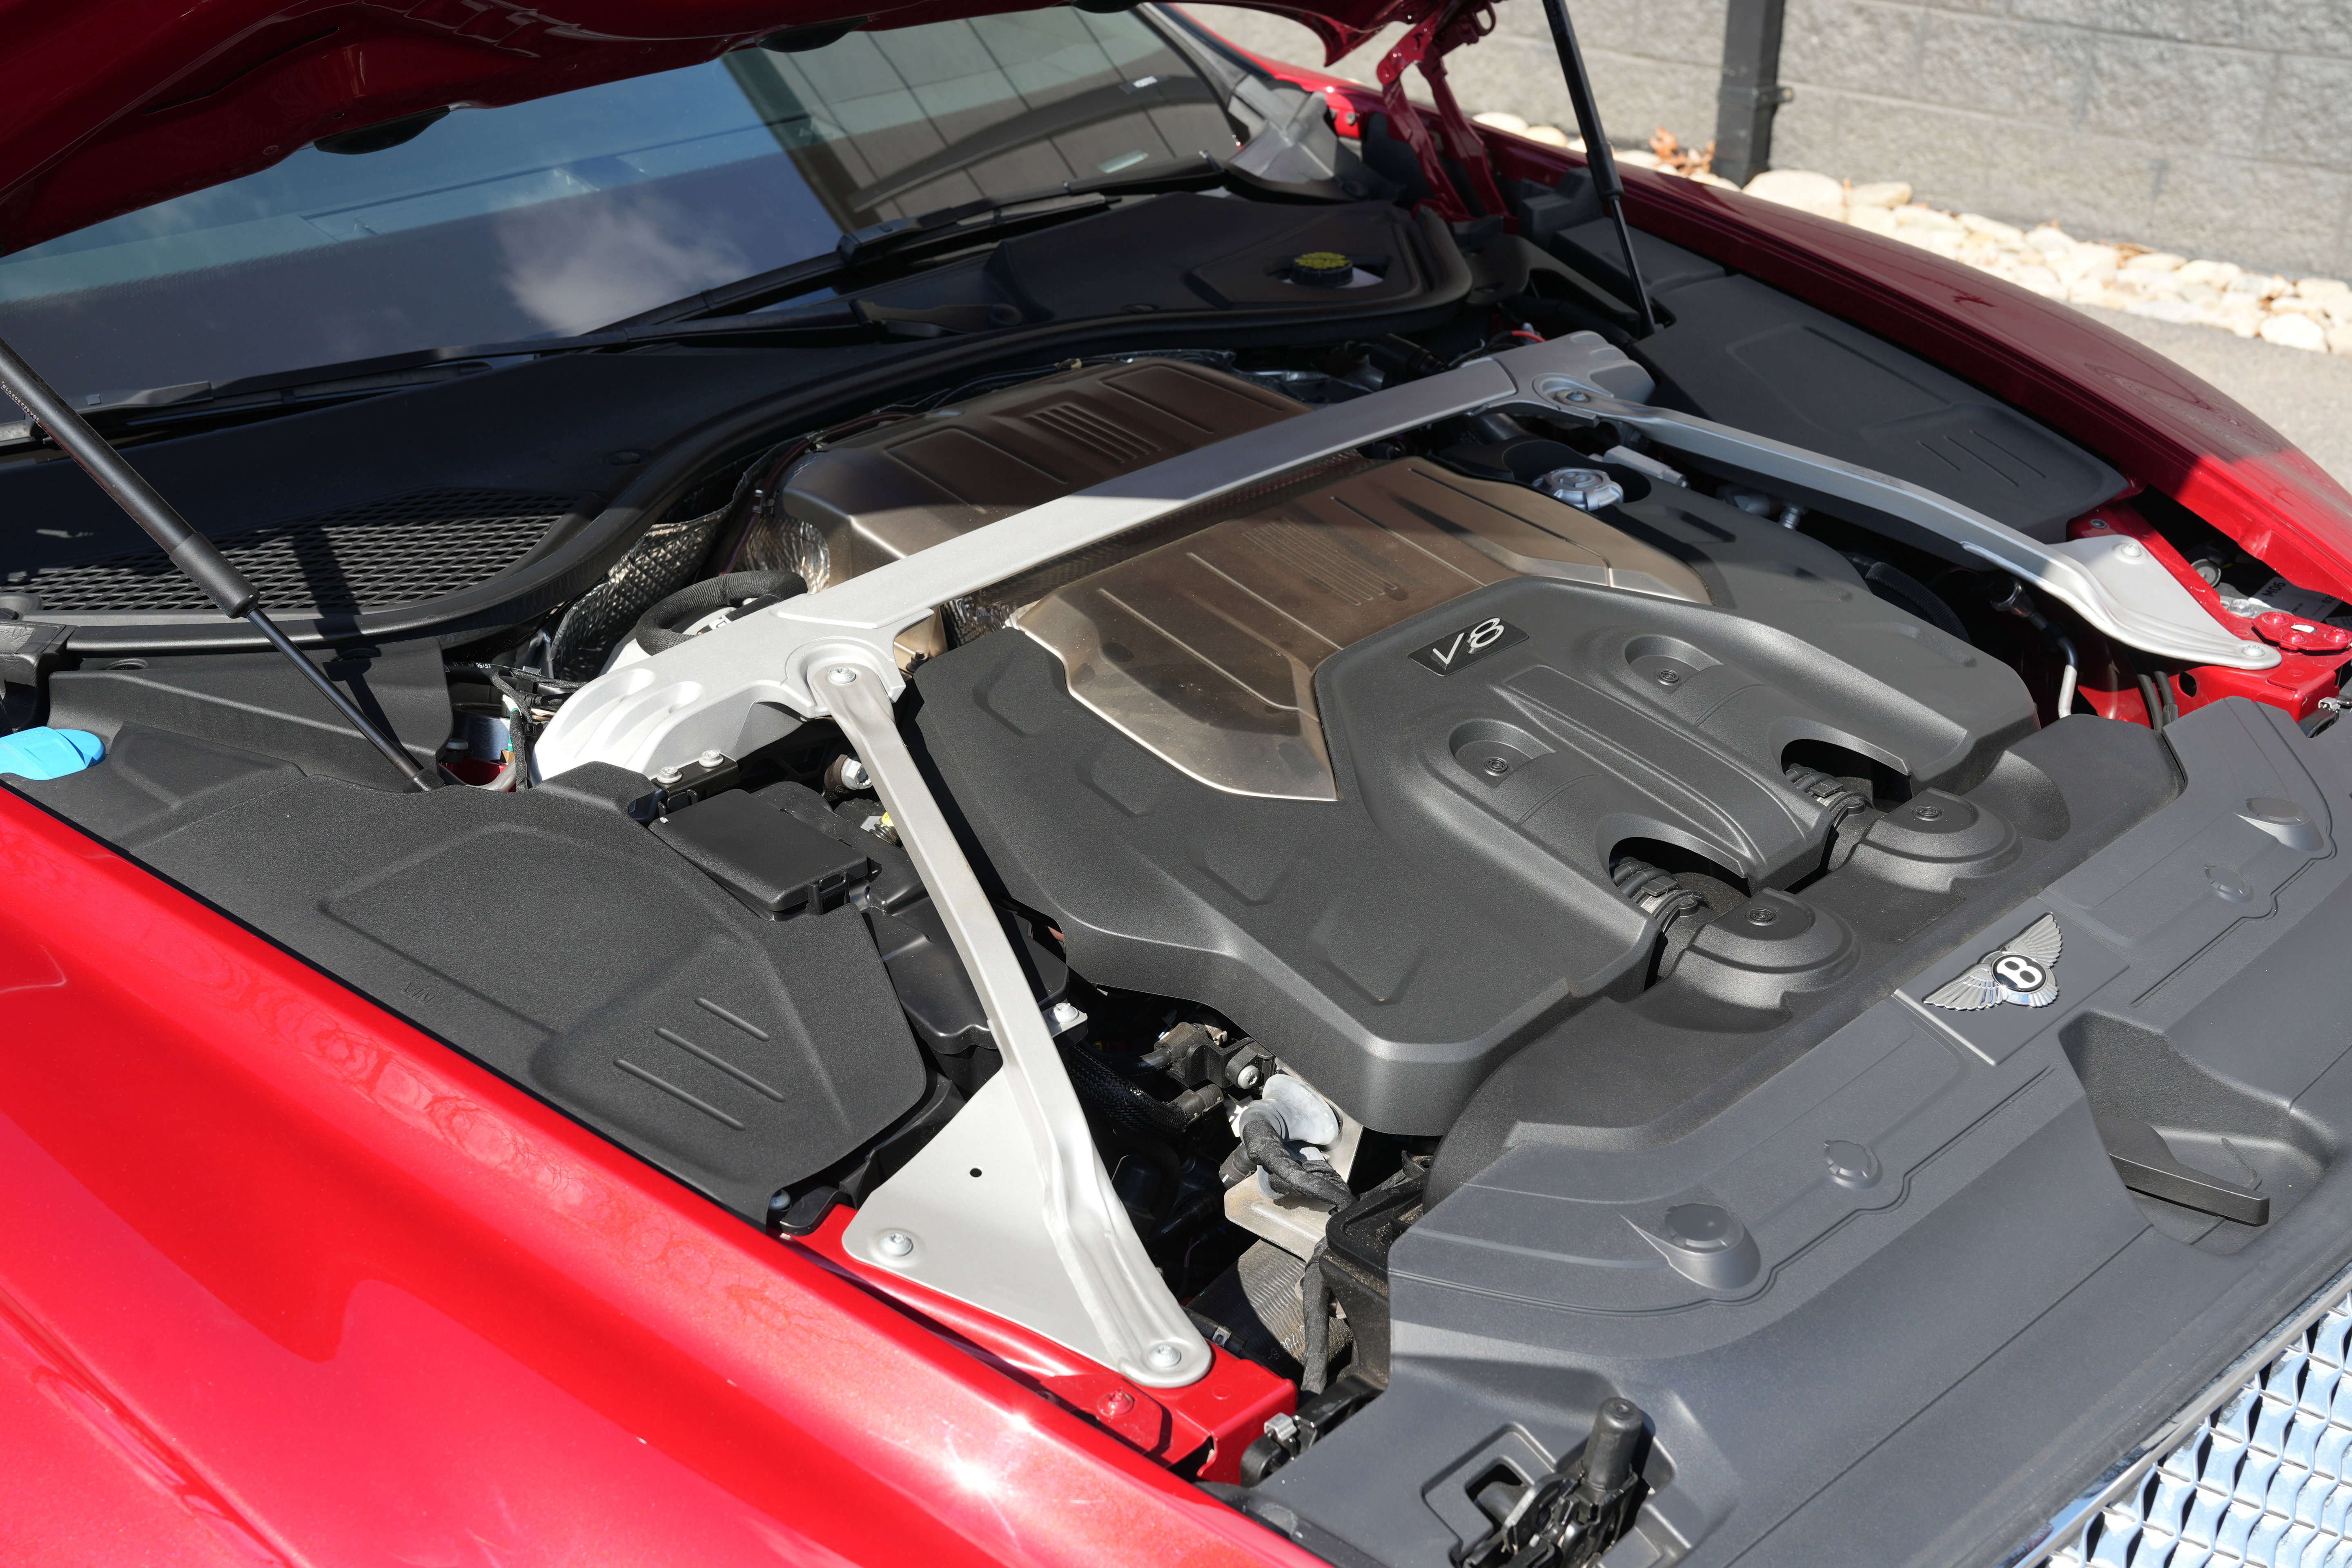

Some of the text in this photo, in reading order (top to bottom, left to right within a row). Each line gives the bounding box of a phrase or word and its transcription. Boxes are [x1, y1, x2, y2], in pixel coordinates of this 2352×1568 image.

[1560, 472, 1596, 488] B
[2261, 581, 2286, 597] M06
[1432, 618, 1505, 665] V8
[1997, 957, 2042, 989] B
[405, 982, 436, 1004] VIN
